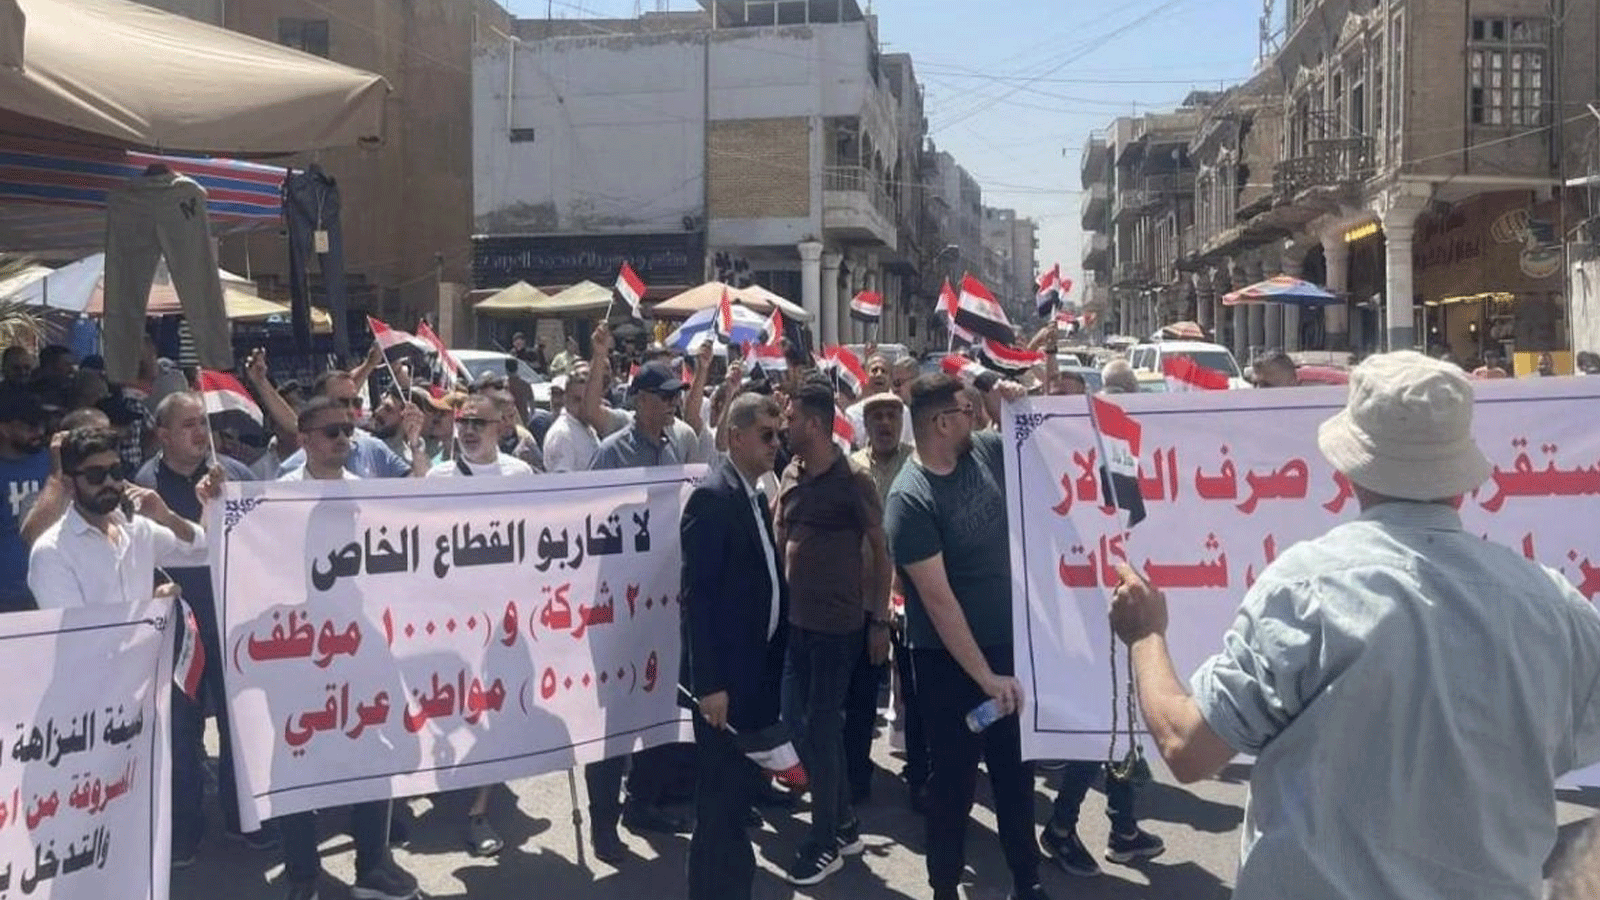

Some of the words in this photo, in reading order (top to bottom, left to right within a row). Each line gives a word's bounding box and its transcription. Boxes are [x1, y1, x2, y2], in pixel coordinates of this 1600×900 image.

[1051, 446, 1179, 517] اللار
[1195, 444, 1308, 515] صرف
[311, 524, 420, 592] الخاص
[434, 518, 525, 579] القطاع
[534, 513, 623, 572] تحاربو
[633, 508, 650, 552] لا
[285, 682, 390, 758] عراقي
[403, 668, 507, 734] مواطن
[12, 709, 96, 768] النزاهة
[26, 789, 60, 831] من
[20, 824, 111, 895] والتدخل
